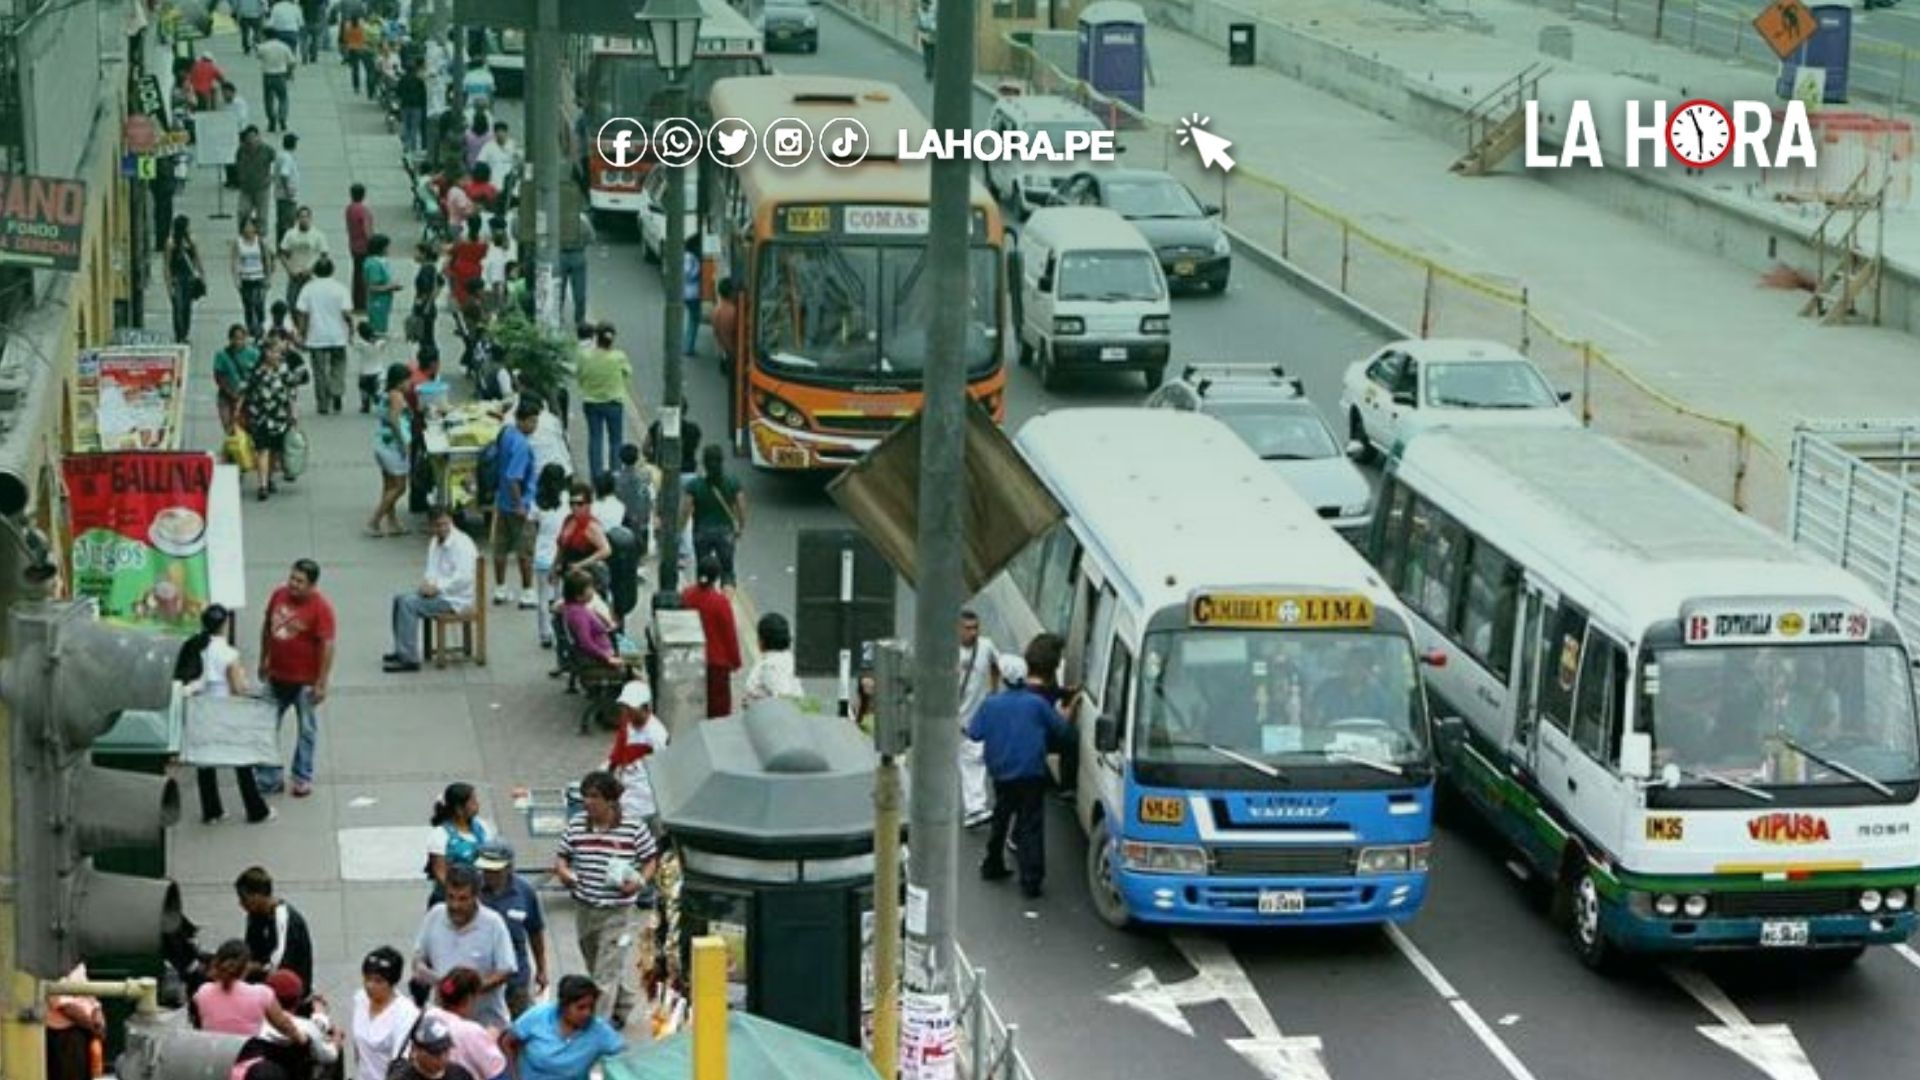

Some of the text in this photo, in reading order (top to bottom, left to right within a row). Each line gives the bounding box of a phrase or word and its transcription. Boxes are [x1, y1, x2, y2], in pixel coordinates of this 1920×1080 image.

[0, 176, 82, 224] ANO
[1305, 599, 1369, 621] LIMA
[1747, 812, 1831, 841] VIPUSA
